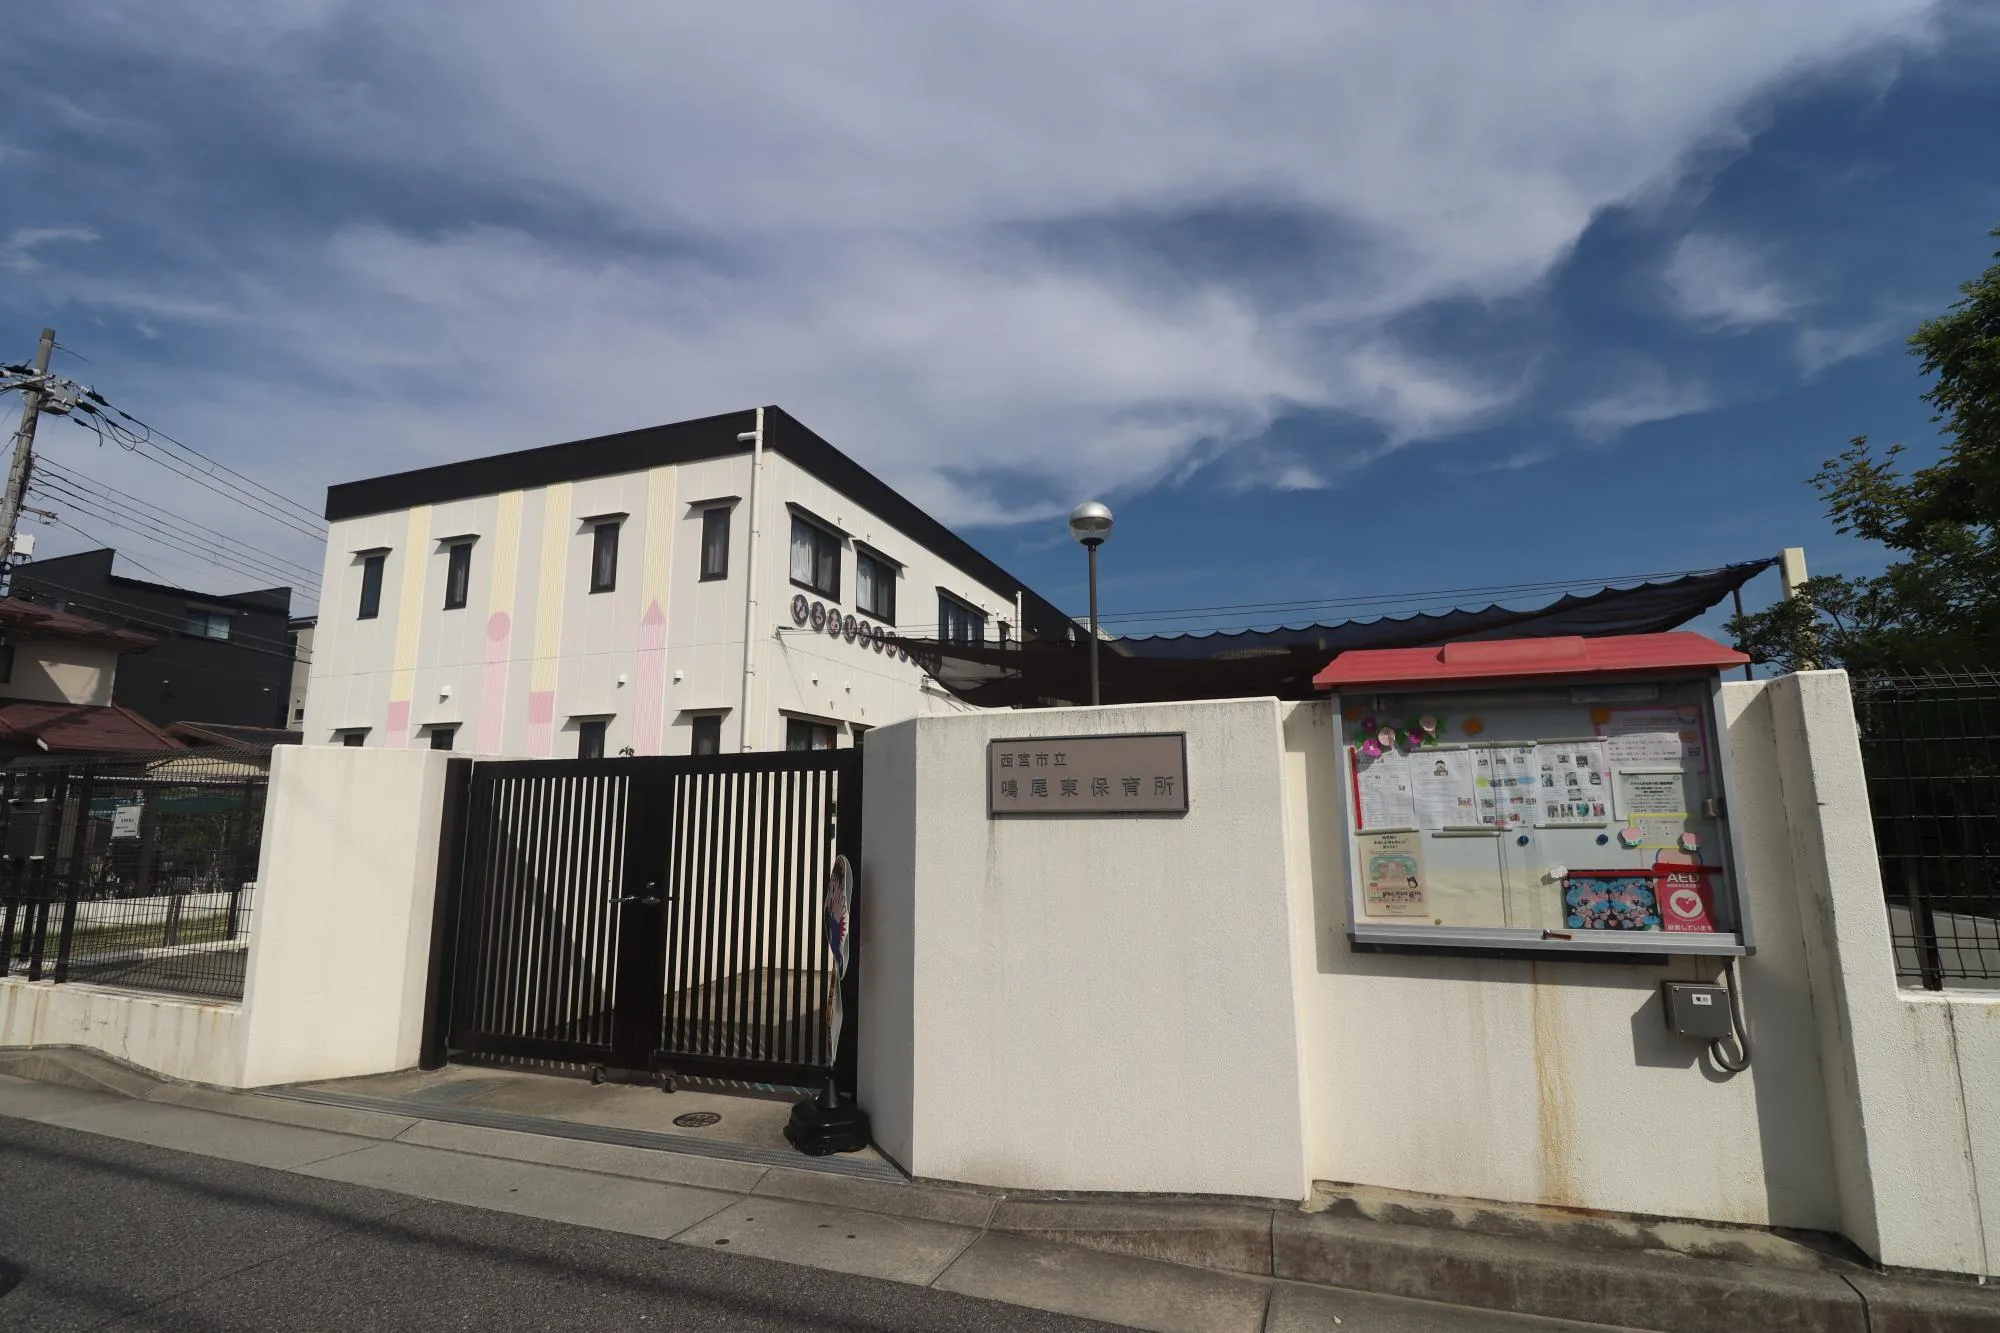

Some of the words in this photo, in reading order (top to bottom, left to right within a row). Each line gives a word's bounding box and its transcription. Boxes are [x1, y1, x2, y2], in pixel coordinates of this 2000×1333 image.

[1000, 751, 1067, 768] 西宮市立
[1001, 776, 1175, 799] 鳴尾東保育所
[1667, 872, 1700, 883] AED
